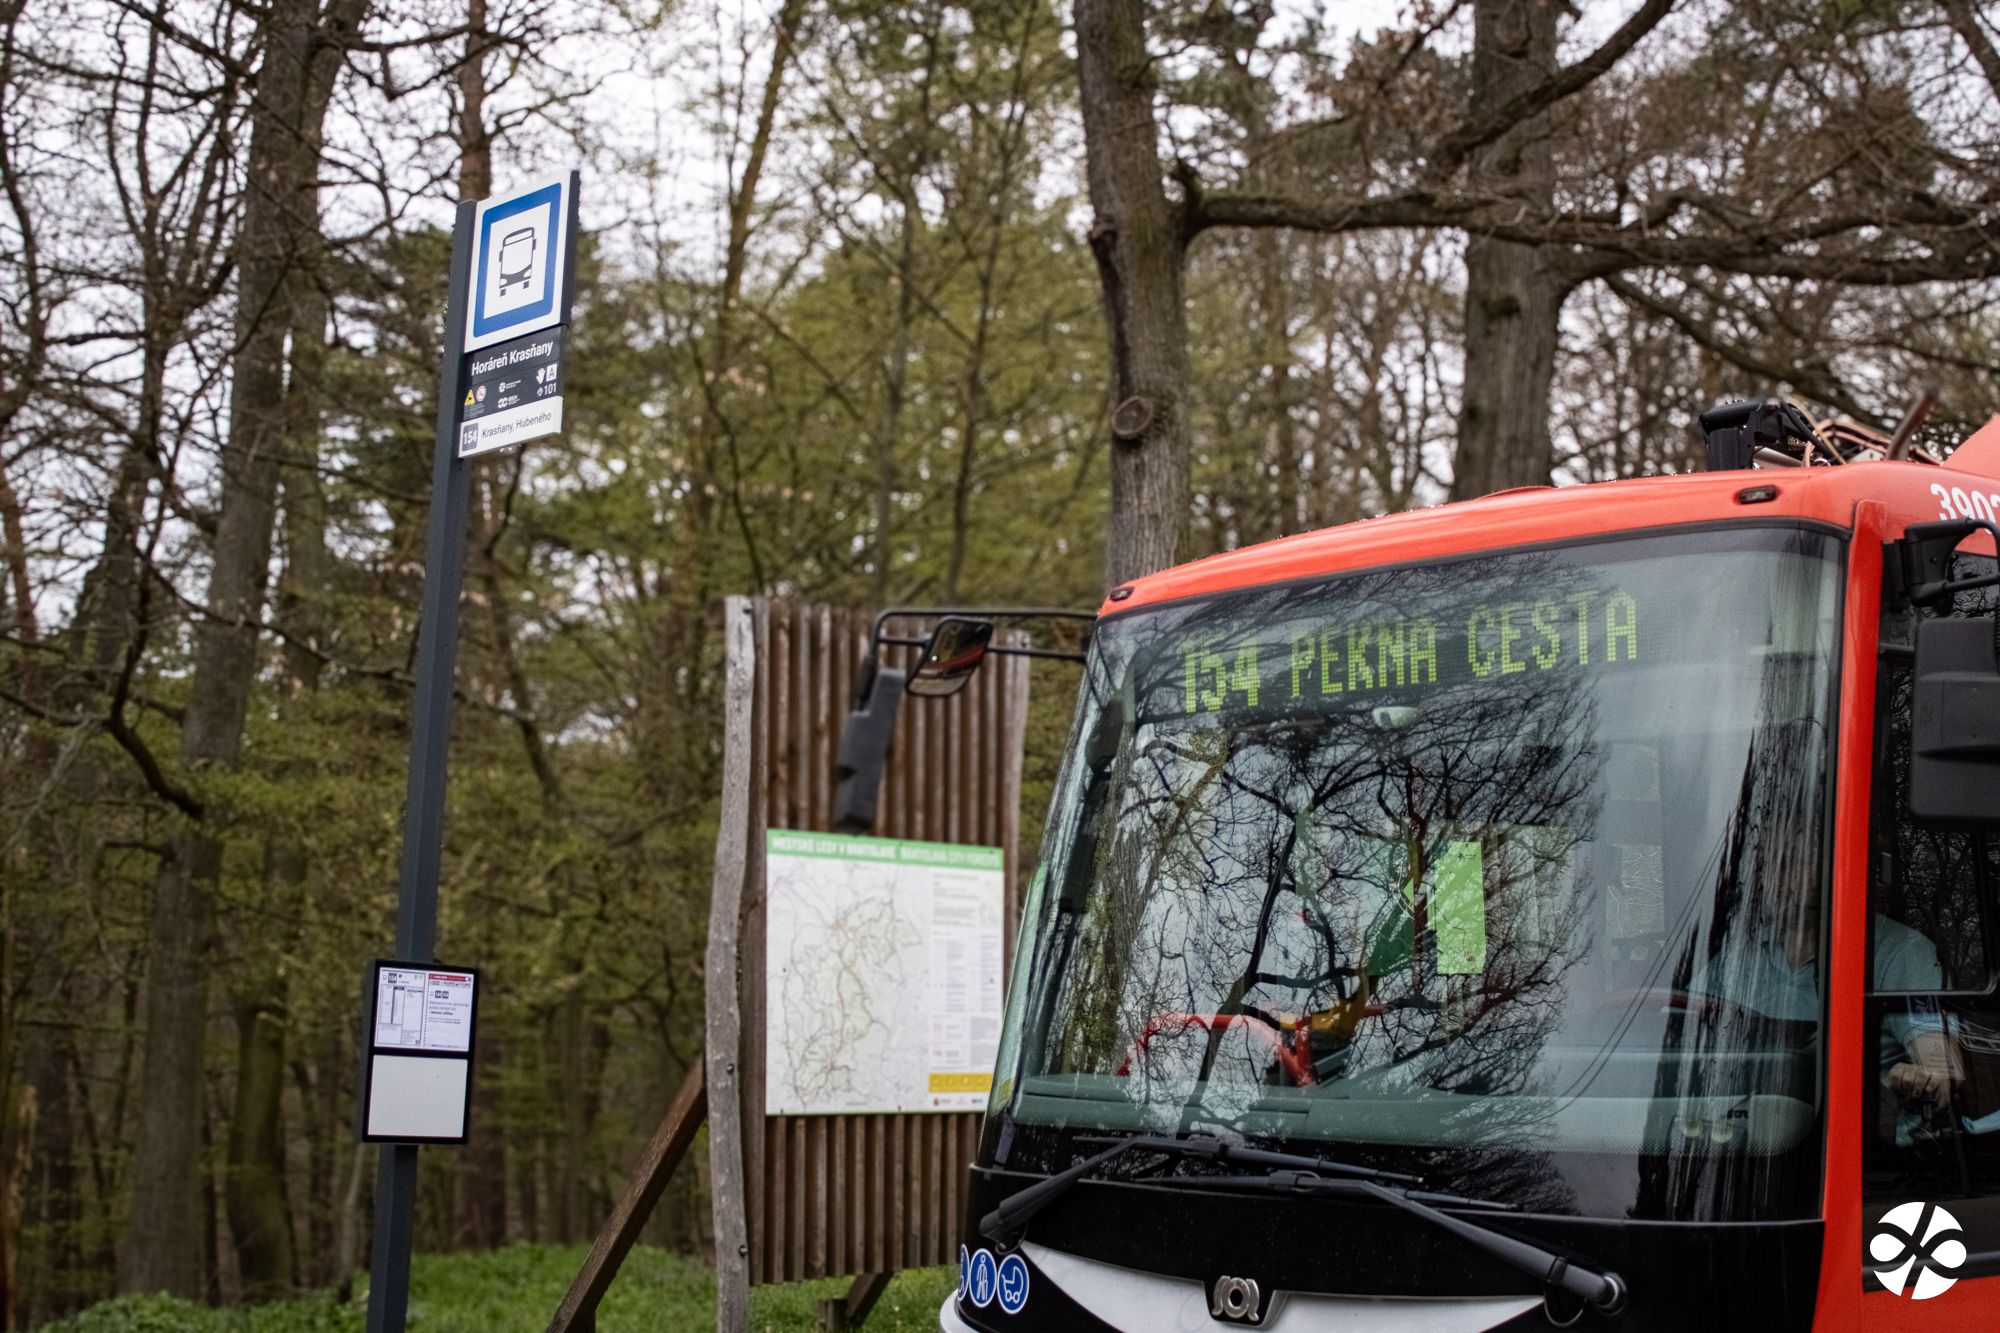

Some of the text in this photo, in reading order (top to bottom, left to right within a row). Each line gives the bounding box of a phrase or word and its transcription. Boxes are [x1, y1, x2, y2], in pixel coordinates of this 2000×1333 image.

[471, 341, 553, 376] Horáreň Krasňany
[549, 367, 555, 378] A
[543, 383, 557, 396] 101
[463, 431, 478, 445] 154
[516, 412, 551, 429] Hubeného
[1930, 483, 2000, 524] 390
[1178, 632, 1261, 714] 154
[1468, 591, 1637, 677] CESTA
